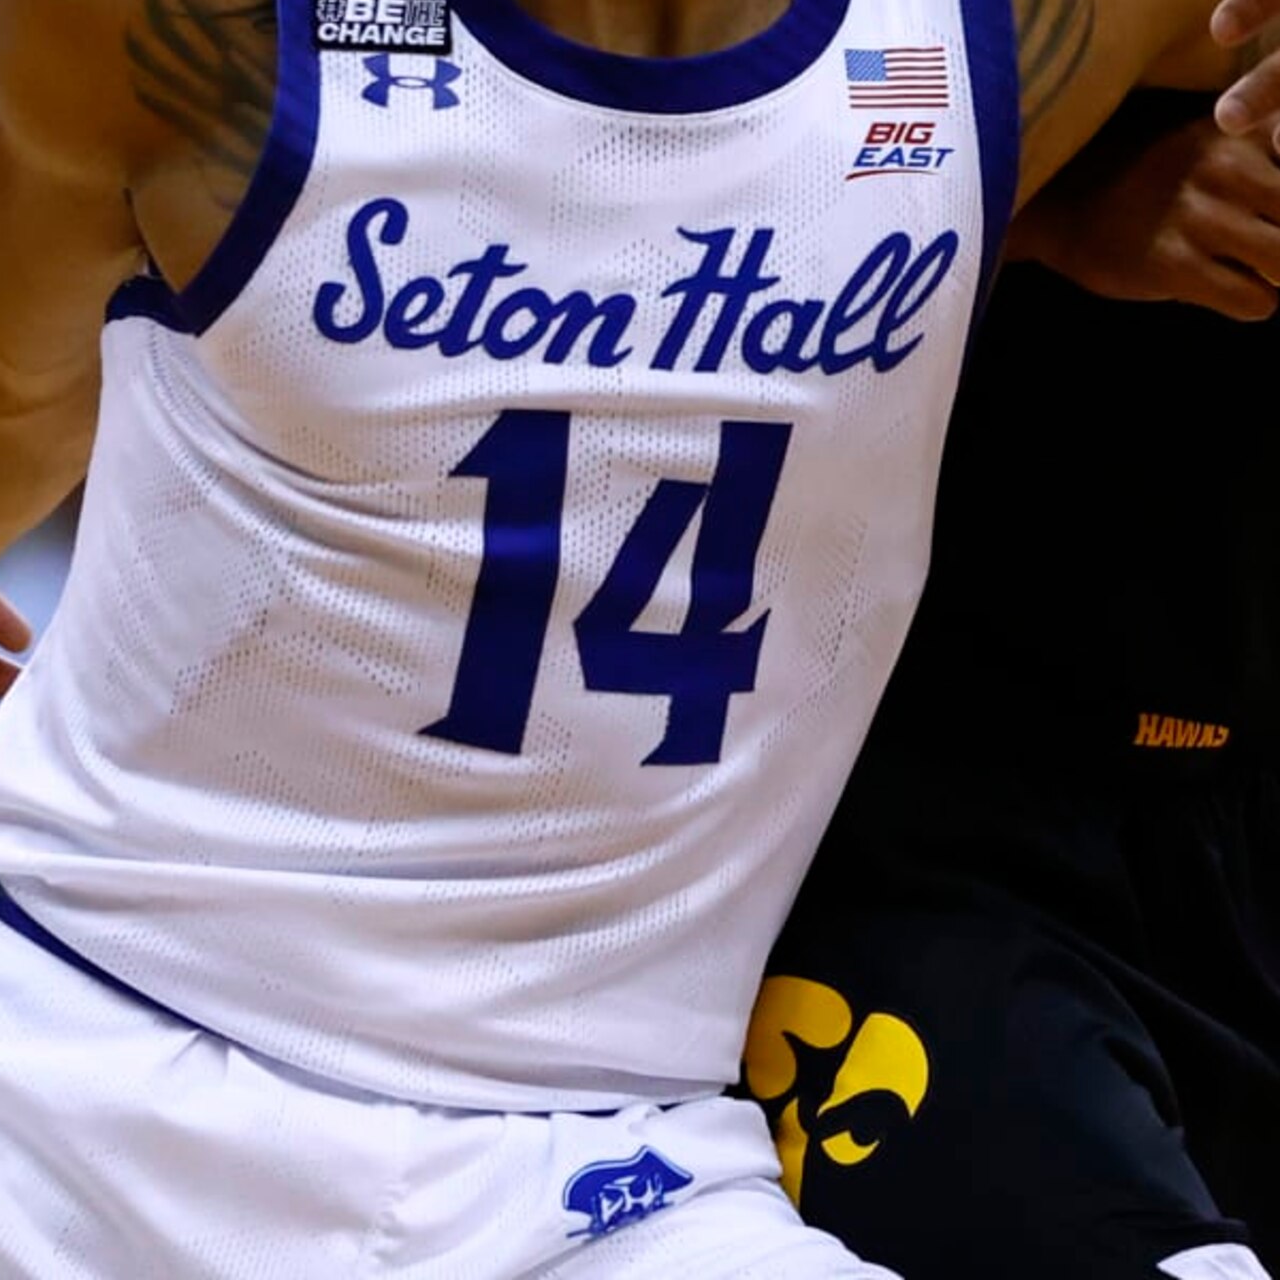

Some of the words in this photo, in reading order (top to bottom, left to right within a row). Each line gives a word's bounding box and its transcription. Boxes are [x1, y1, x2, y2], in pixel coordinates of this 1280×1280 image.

[317, 22, 446, 46] CHANGE
[865, 122, 936, 144] BIG
[853, 147, 955, 168] EAST
[315, 198, 638, 368] Seton
[650, 227, 959, 376] Hall
[417, 408, 794, 767] 14
